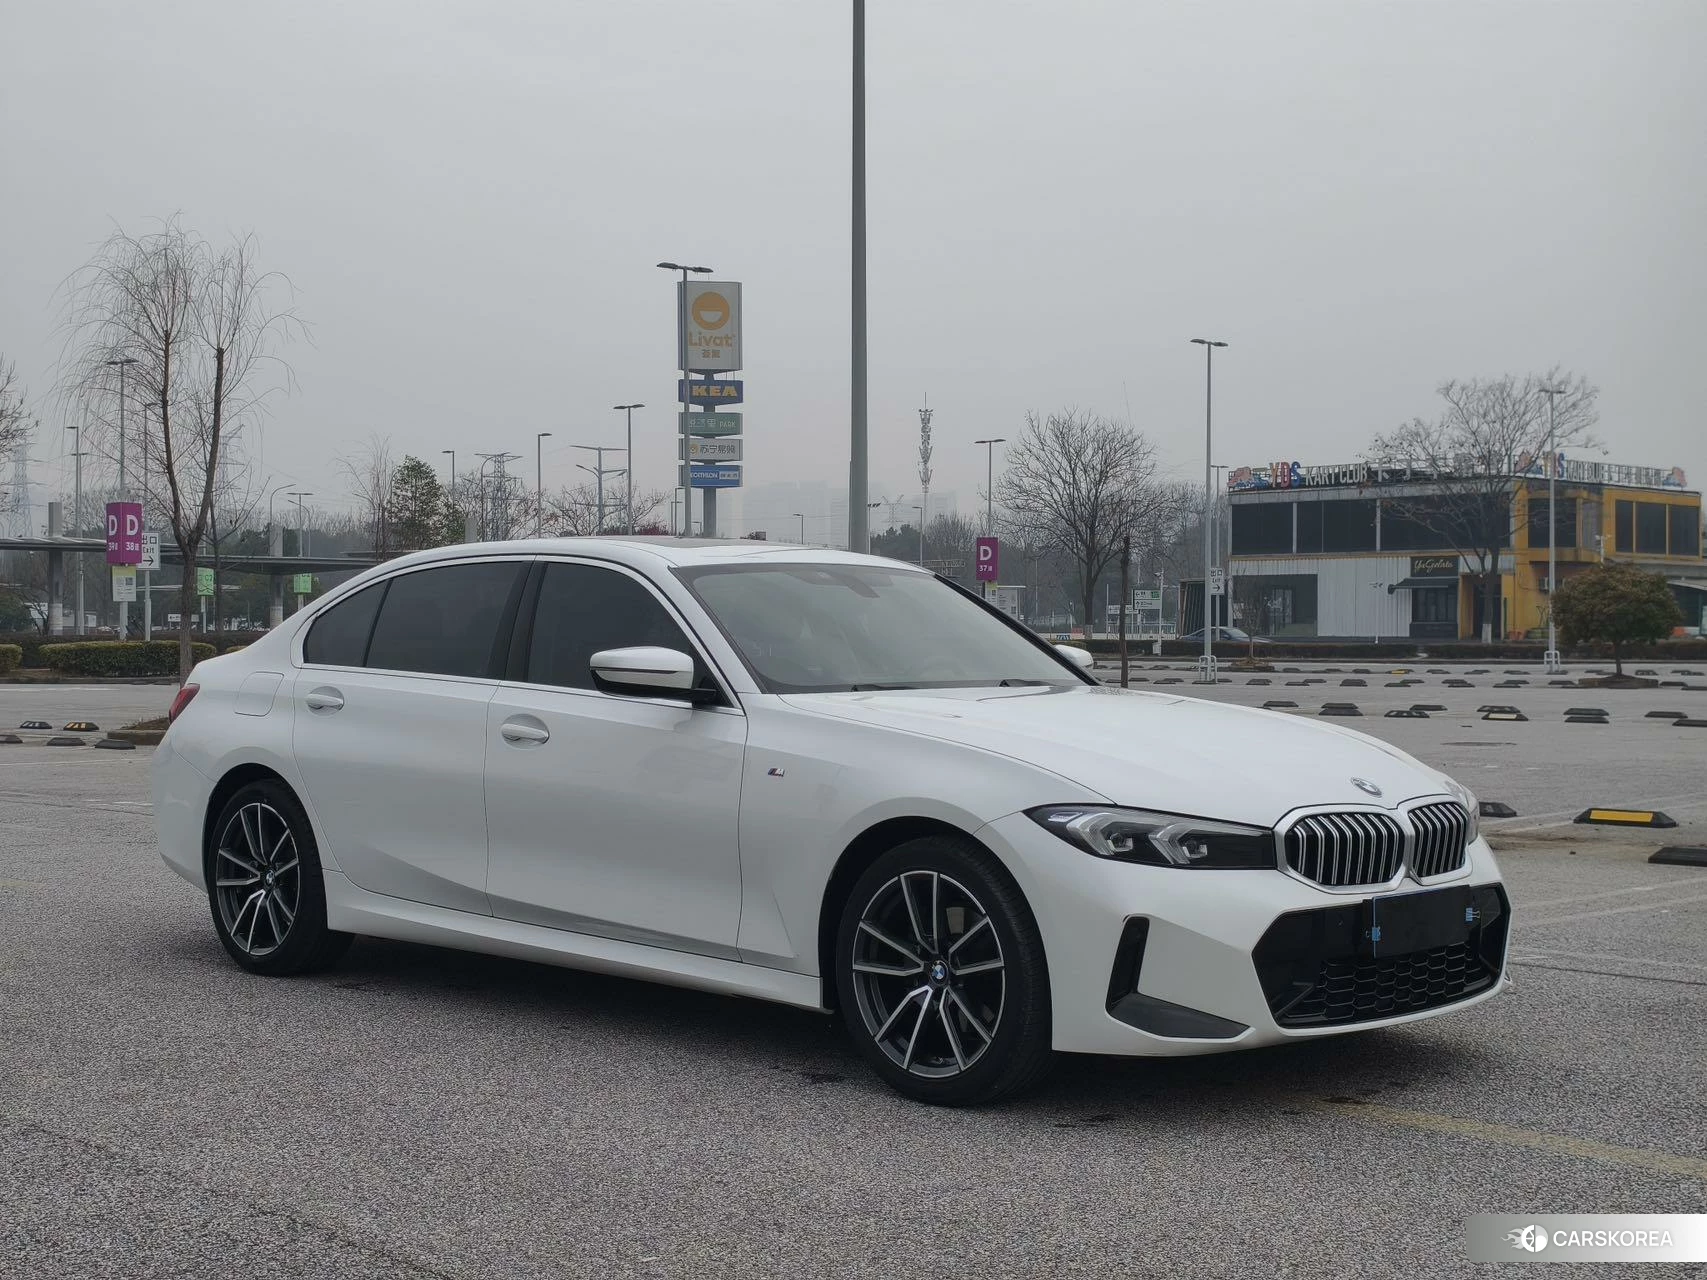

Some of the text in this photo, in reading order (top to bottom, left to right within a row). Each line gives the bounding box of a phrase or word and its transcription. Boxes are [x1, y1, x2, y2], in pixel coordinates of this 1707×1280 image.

[688, 331, 733, 346] Livat
[691, 385, 738, 397] KEA
[1269, 461, 1301, 489] YDS
[1305, 465, 1336, 486] KART
[1339, 462, 1368, 484] CLUB
[108, 514, 118, 536] D
[126, 514, 139, 536] D
[979, 545, 992, 561] D
